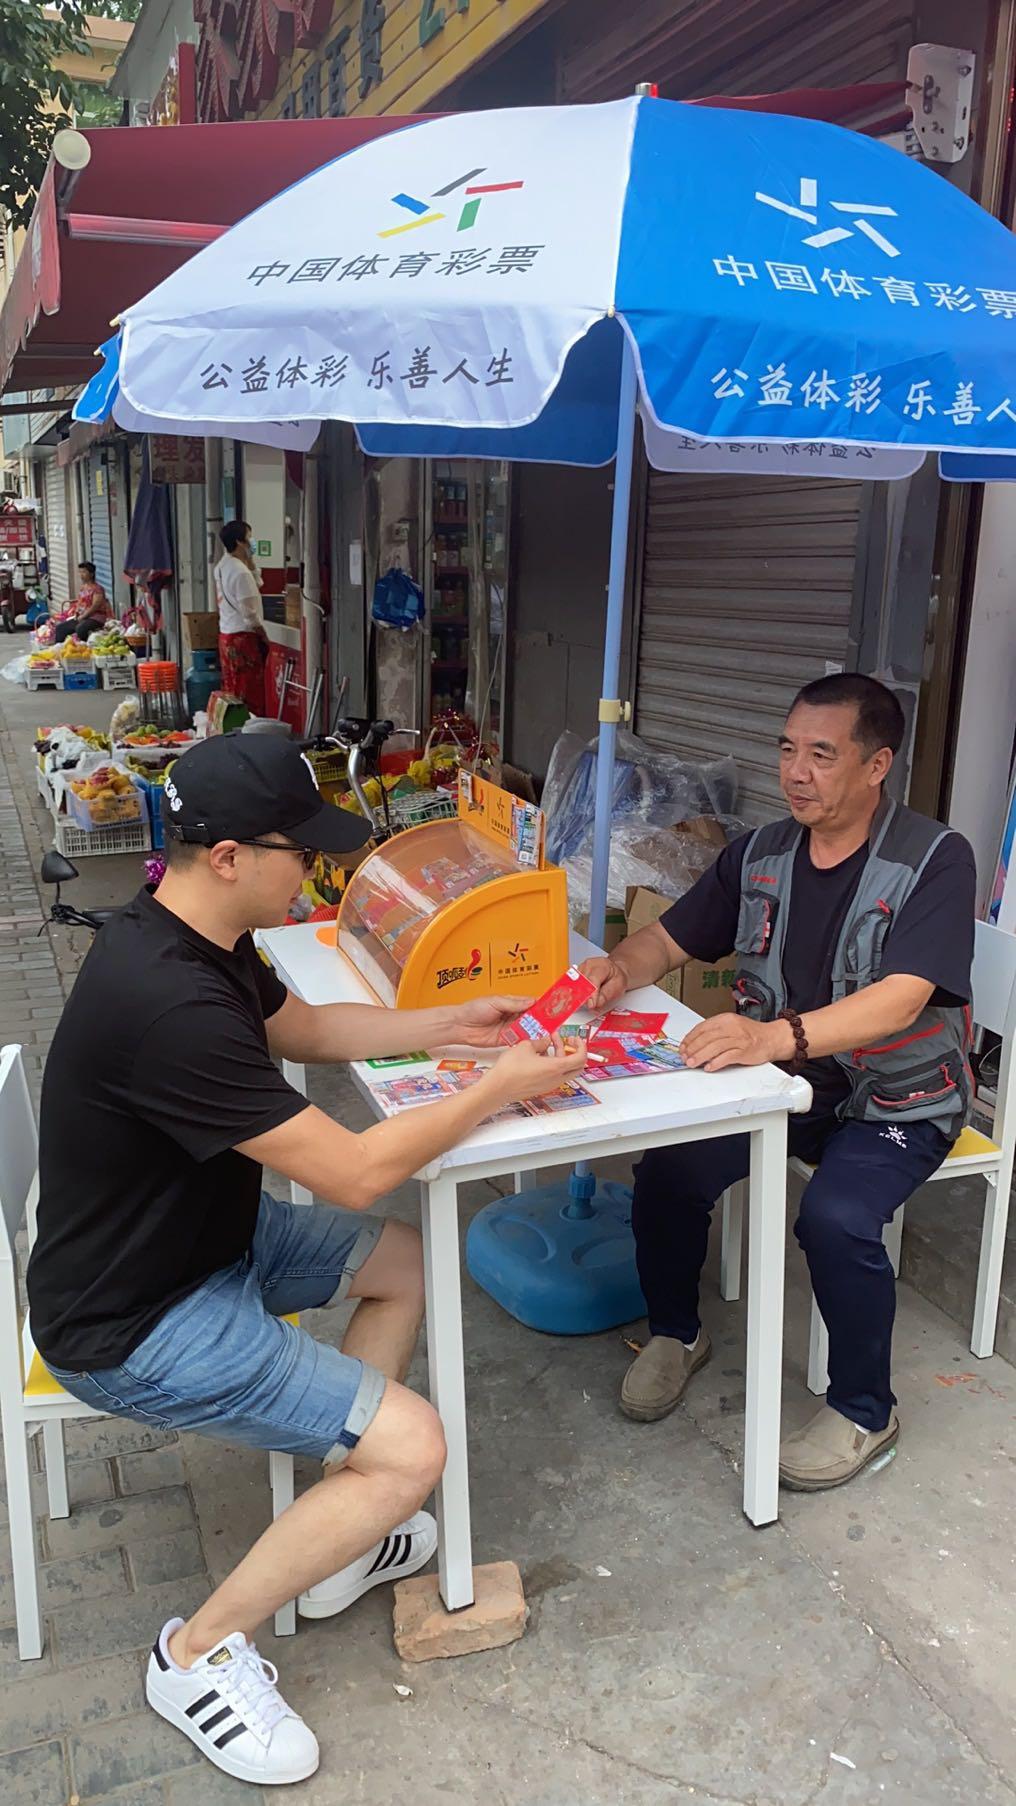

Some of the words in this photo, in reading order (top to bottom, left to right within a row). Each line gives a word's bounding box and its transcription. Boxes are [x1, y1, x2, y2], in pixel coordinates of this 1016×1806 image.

[247, 244, 546, 287] 中国体育彩票
[712, 255, 1016, 320] 中国体育彩票
[200, 354, 349, 393] 公益体彩
[367, 346, 515, 391] 乐善人生
[711, 363, 882, 414] 公益体彩
[902, 381, 1016, 426] 乐善人
